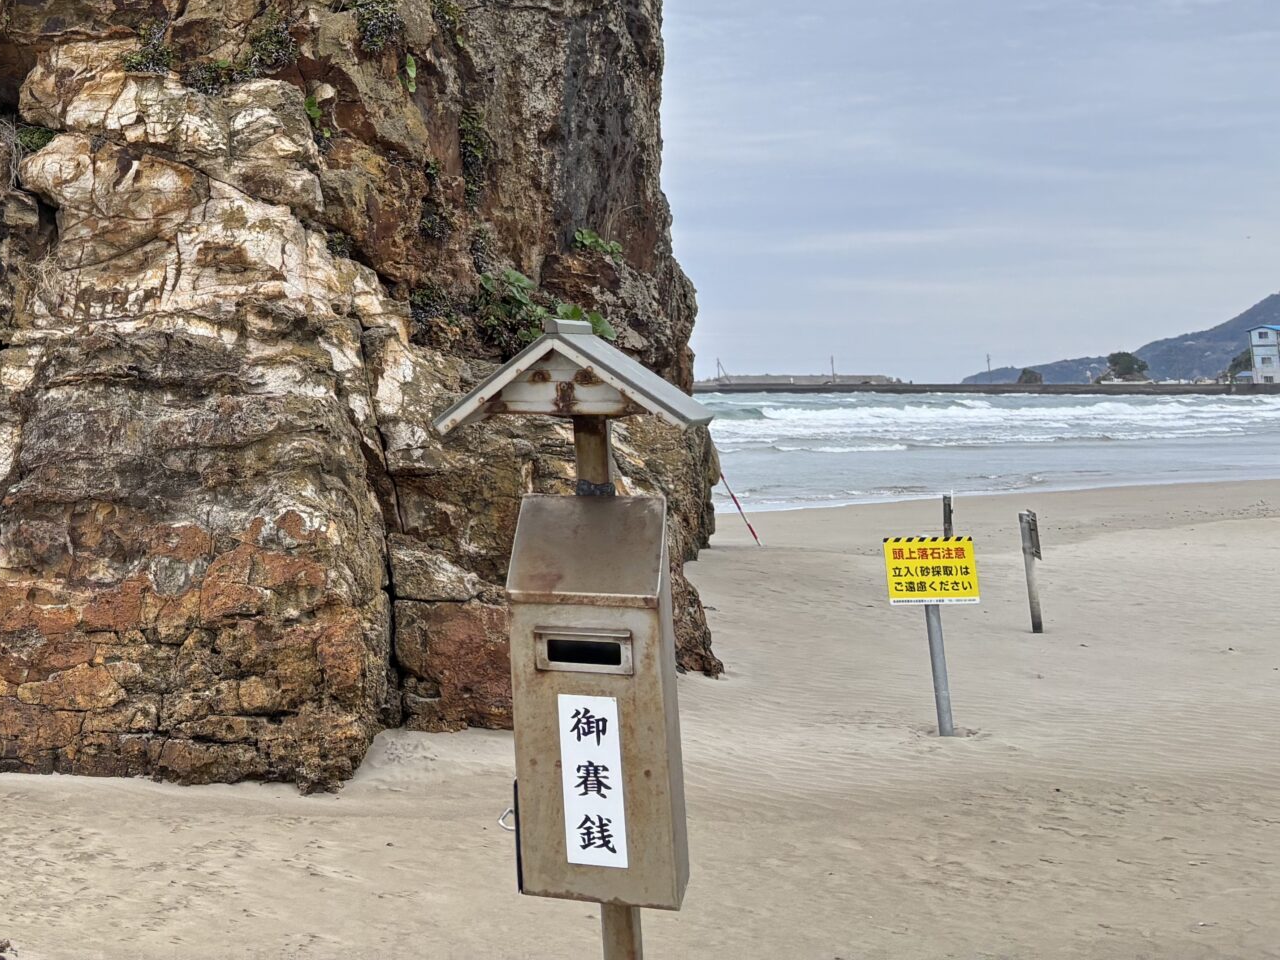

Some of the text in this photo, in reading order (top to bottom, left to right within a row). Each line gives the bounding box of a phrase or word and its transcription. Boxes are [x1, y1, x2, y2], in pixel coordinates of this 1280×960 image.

[892, 547, 966, 560] 頭上落石注意
[894, 581, 973, 592] ご遠慮ください
[569, 707, 617, 854] 御賽銭
